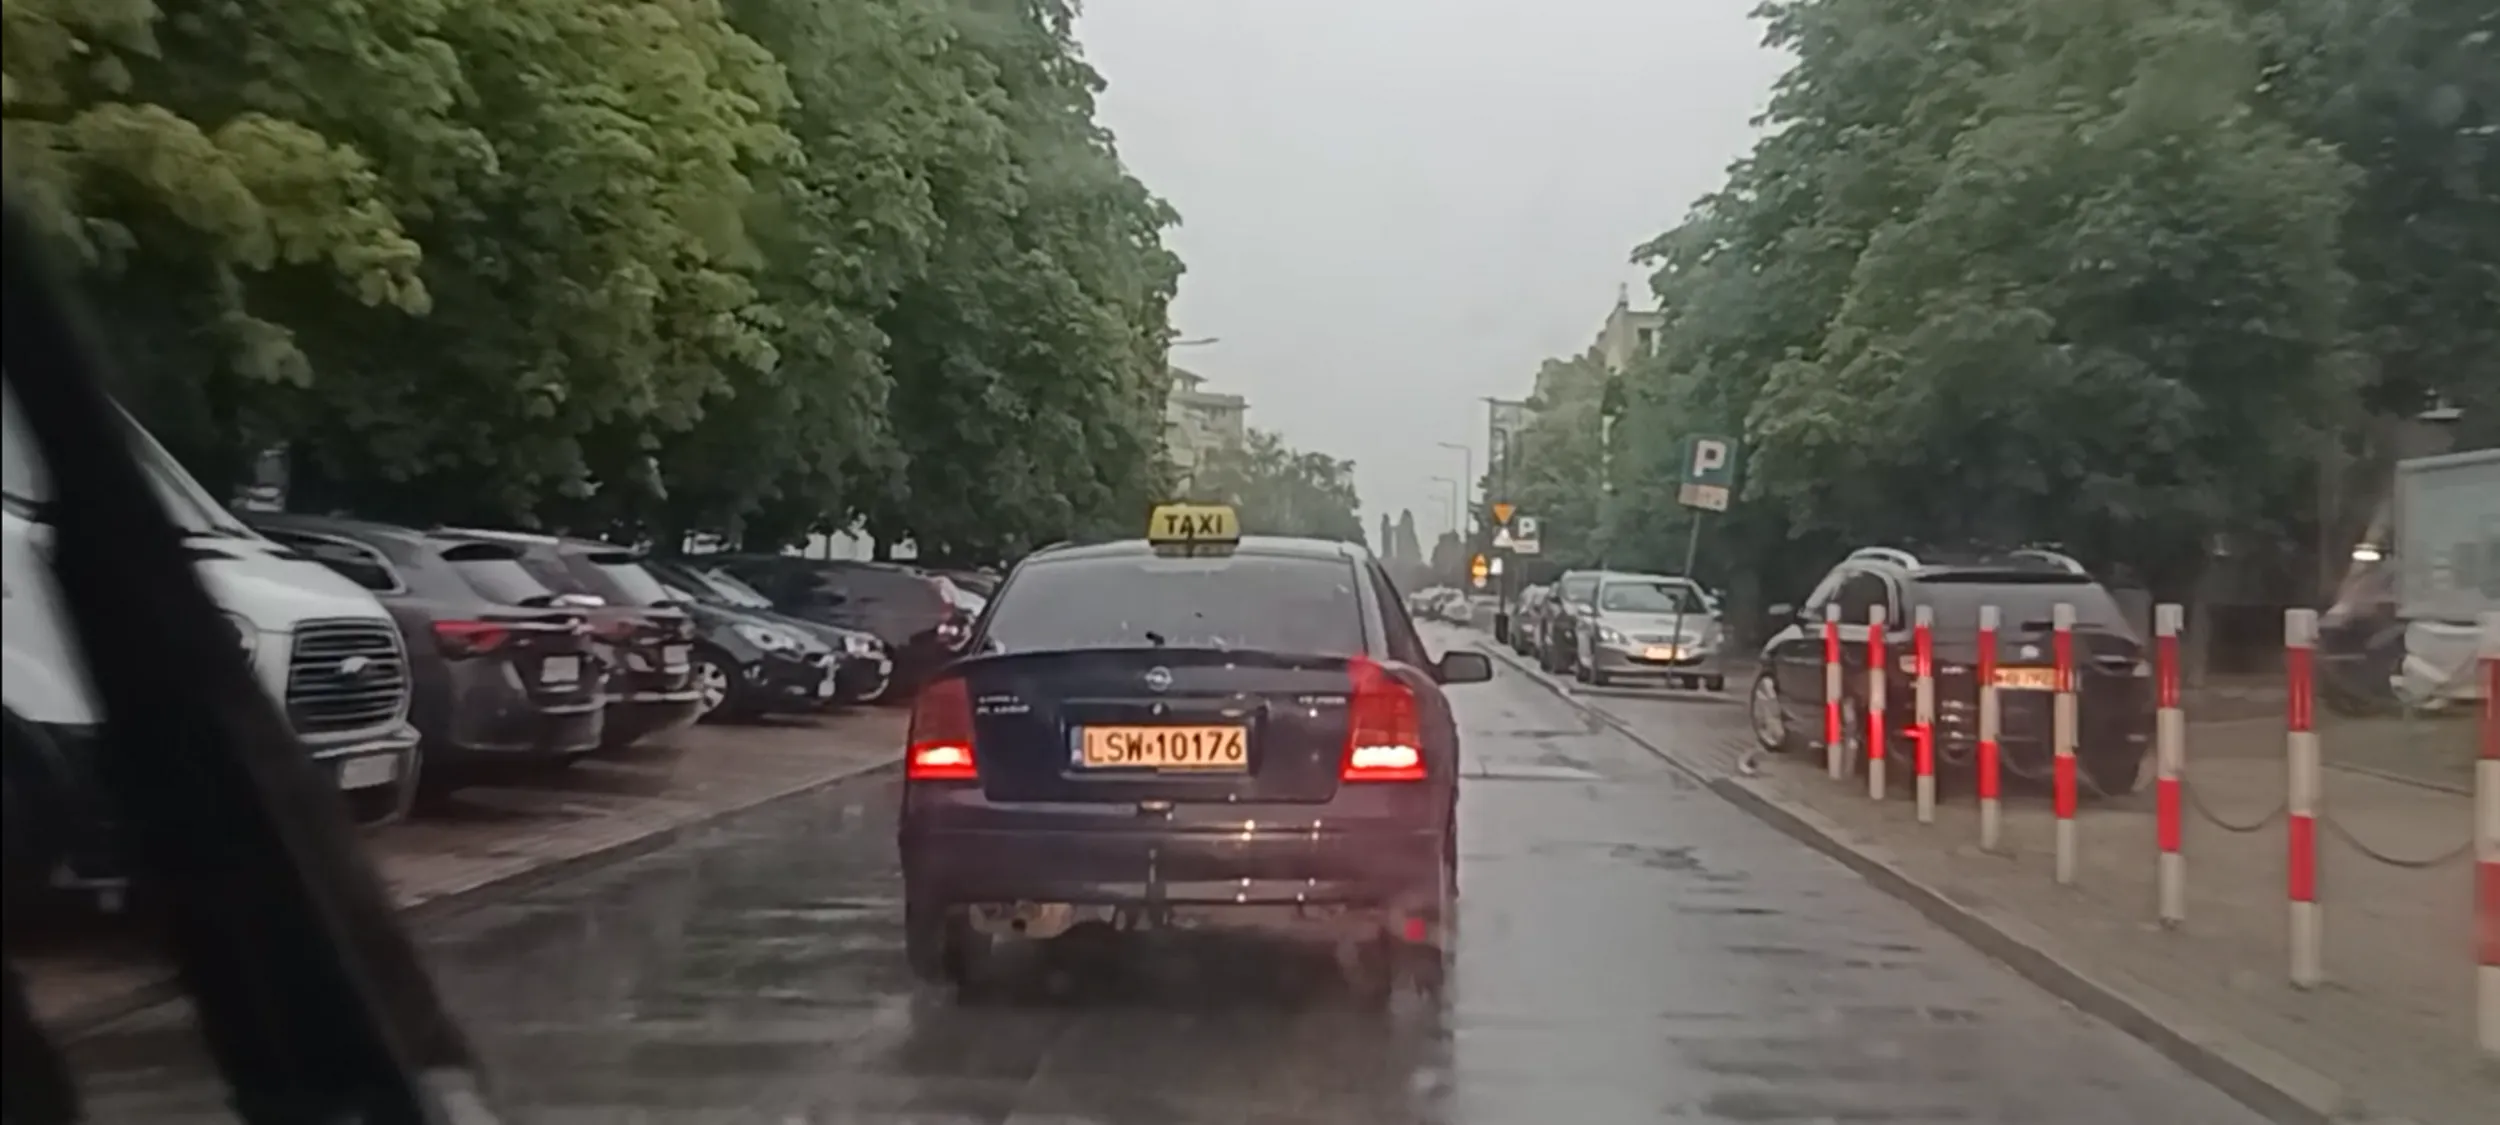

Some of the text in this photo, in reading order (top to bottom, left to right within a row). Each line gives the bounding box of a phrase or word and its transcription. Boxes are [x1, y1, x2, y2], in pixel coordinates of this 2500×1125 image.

[1694, 439, 1726, 477] P
[1164, 514, 1222, 535] TAXI
[1518, 517, 1536, 537] P
[1087, 731, 1242, 762] LSW 10176
